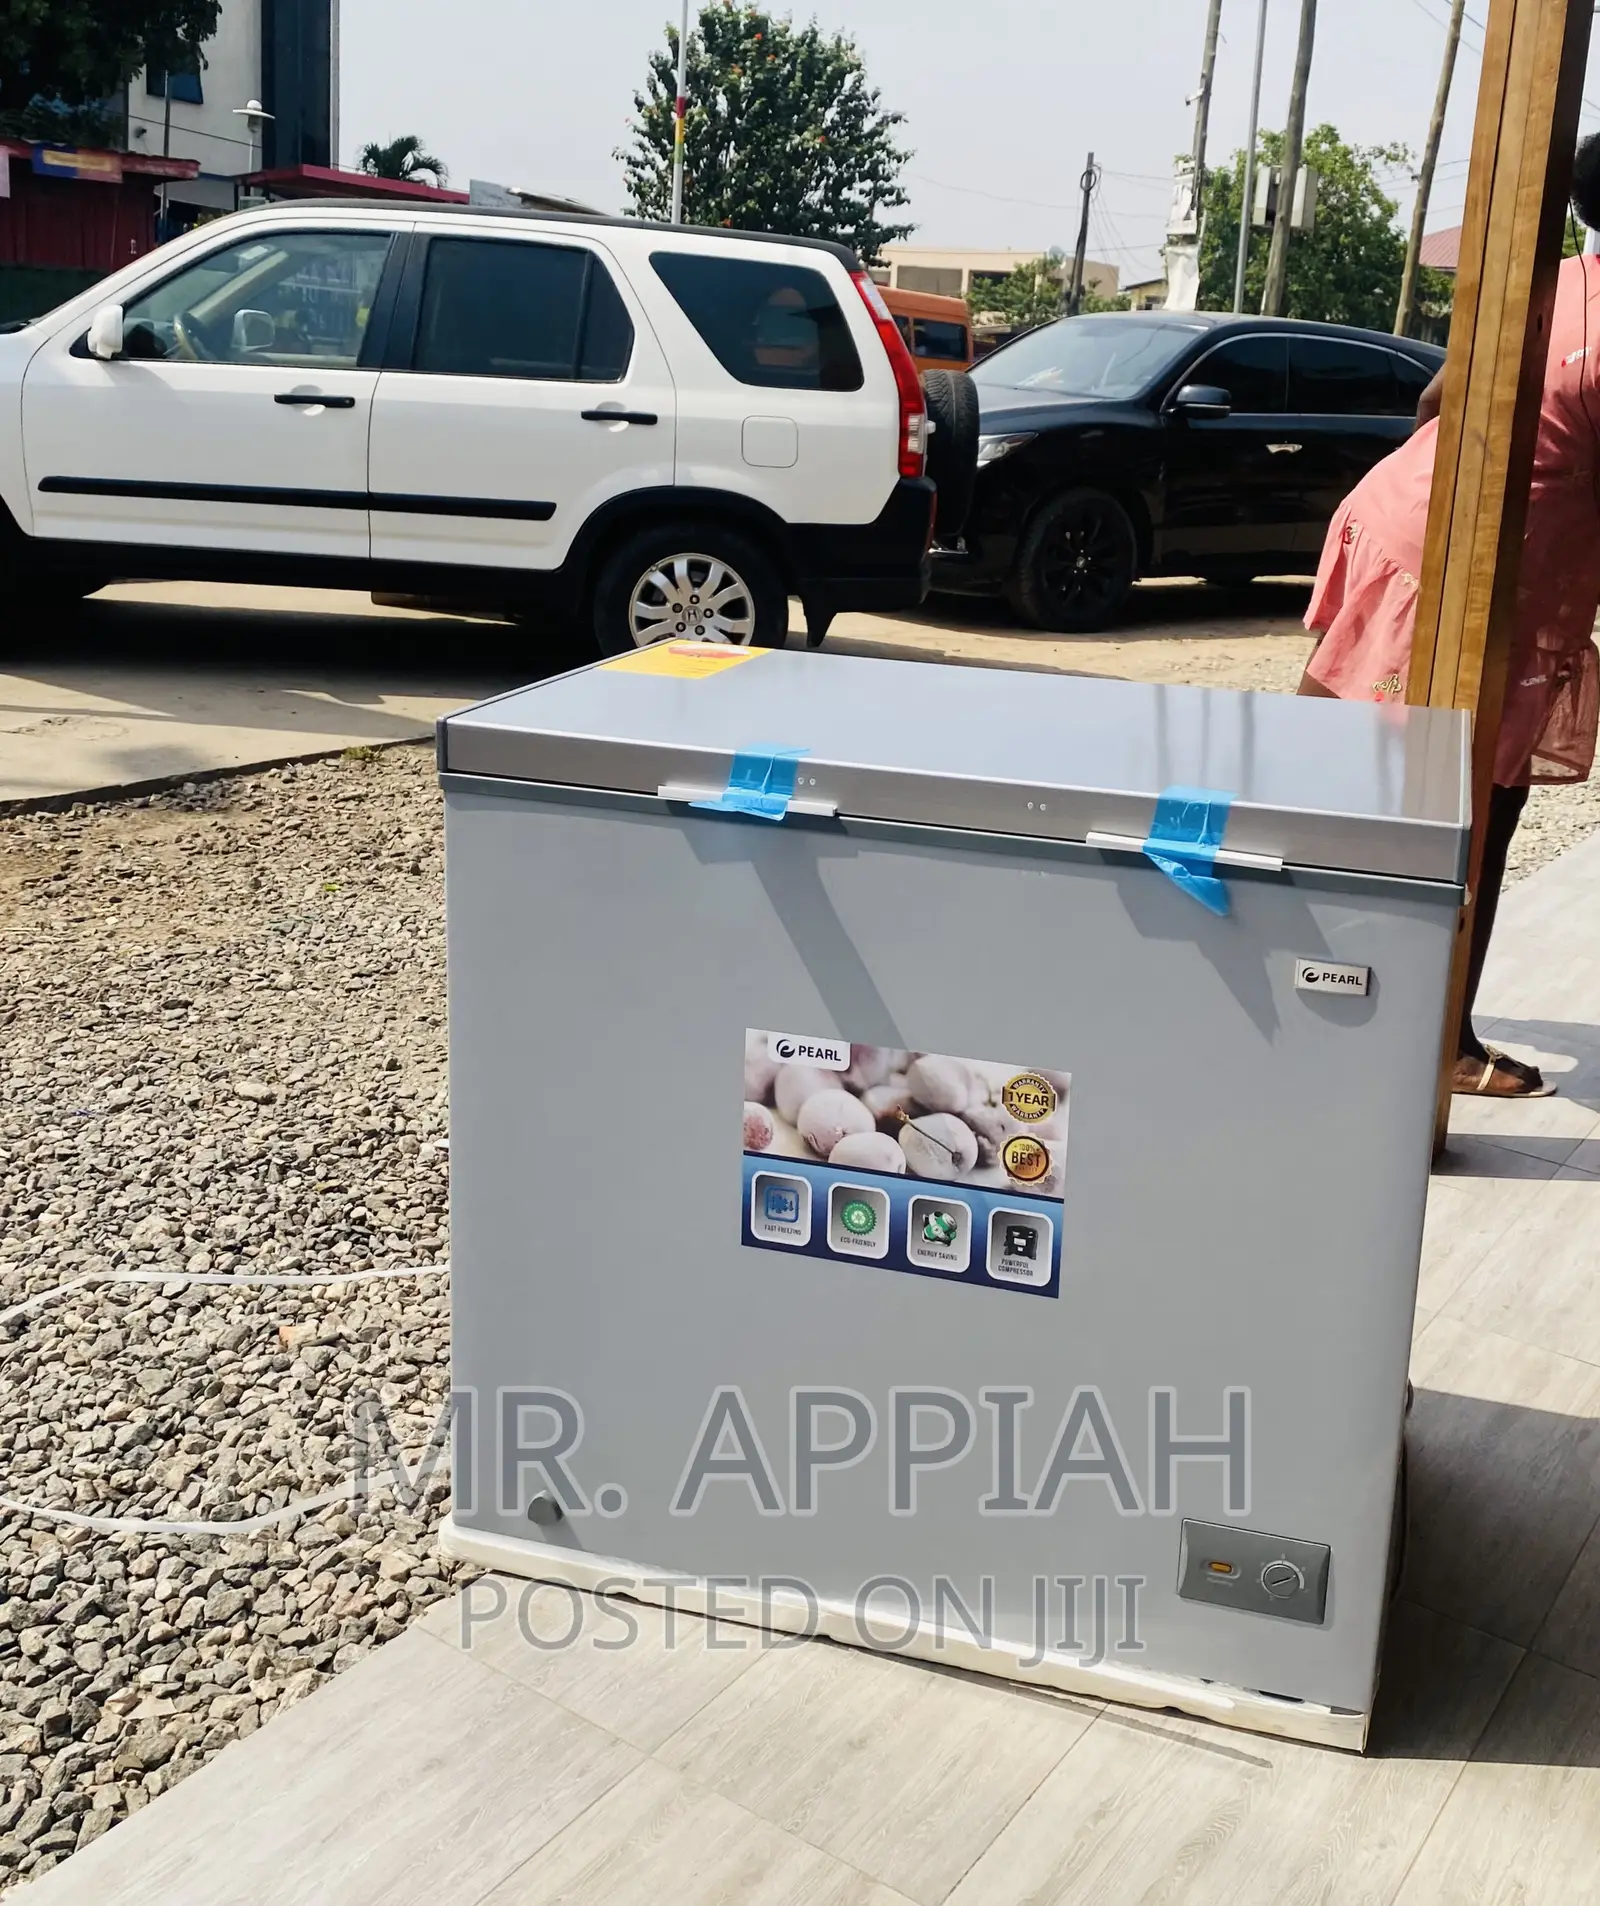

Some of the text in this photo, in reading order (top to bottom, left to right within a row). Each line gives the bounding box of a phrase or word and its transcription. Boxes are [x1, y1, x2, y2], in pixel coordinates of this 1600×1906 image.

[1322, 972, 1363, 986] PEARL
[798, 1045, 842, 1062] PEARL
[1012, 1077, 1047, 1095] WARRANTY
[1008, 1091, 1050, 1108] 1 YEAR
[1011, 1104, 1046, 1120] WARRANTY
[1012, 1150, 1041, 1168] BEST
[764, 1224, 777, 1232] FAST
[840, 1236, 876, 1248] ECO-FRIENDLY
[917, 1248, 958, 1261] ENERGY SAVING
[1001, 1257, 1029, 1269] POWERFUL
[998, 1264, 1034, 1277] COMPRESSOR
